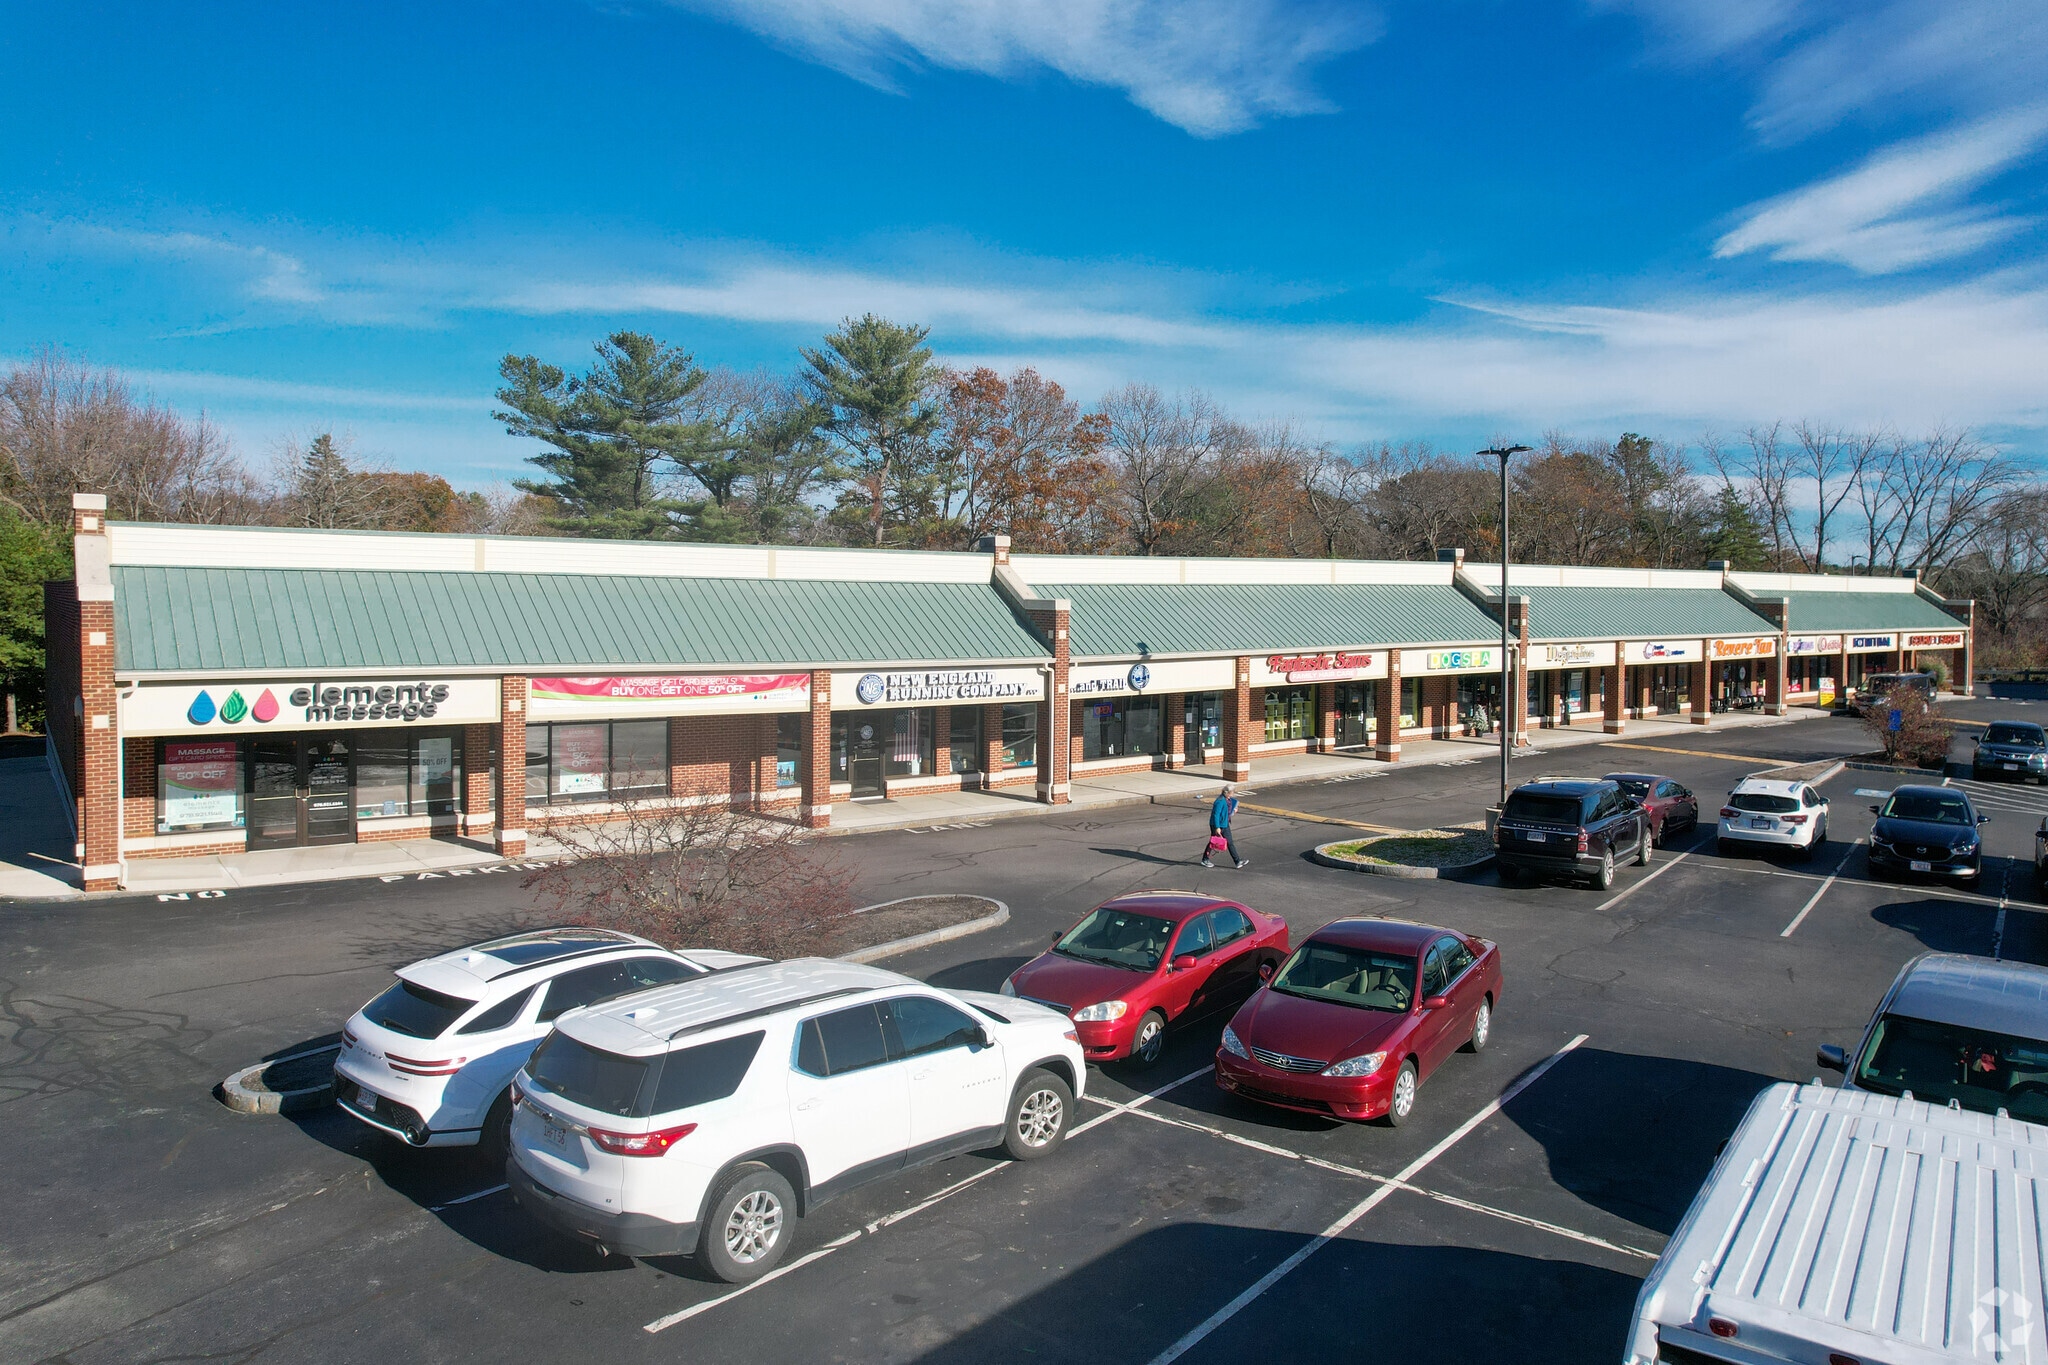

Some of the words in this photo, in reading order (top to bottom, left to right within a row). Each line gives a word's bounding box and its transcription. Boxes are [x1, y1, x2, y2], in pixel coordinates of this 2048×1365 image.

[1714, 640, 1752, 656] Revere
[1754, 638, 1772, 654] Tan
[1267, 653, 1333, 673] Fantastic
[1334, 651, 1372, 669] Sams
[621, 678, 659, 687] MASSAGE
[660, 677, 678, 687] GIFT
[678, 677, 700, 687] CARD
[887, 674, 925, 687] NEW
[926, 671, 997, 687] ENGLAND
[290, 682, 449, 706] elements
[611, 686, 634, 697] BUY
[661, 685, 682, 696] GET
[683, 685, 705, 695] ONE
[707, 685, 725, 695] 50%
[726, 684, 745, 694] OFF
[887, 685, 958, 702] RUNNING
[306, 702, 438, 722] massage
[177, 748, 225, 756] MASSAGE
[422, 758, 436, 766] 50%
[436, 757, 448, 766] OFF
[571, 759, 591, 768] OFF
[177, 771, 201, 780] 50%
[202, 770, 226, 779] OFF
[157, 890, 227, 902] NO
